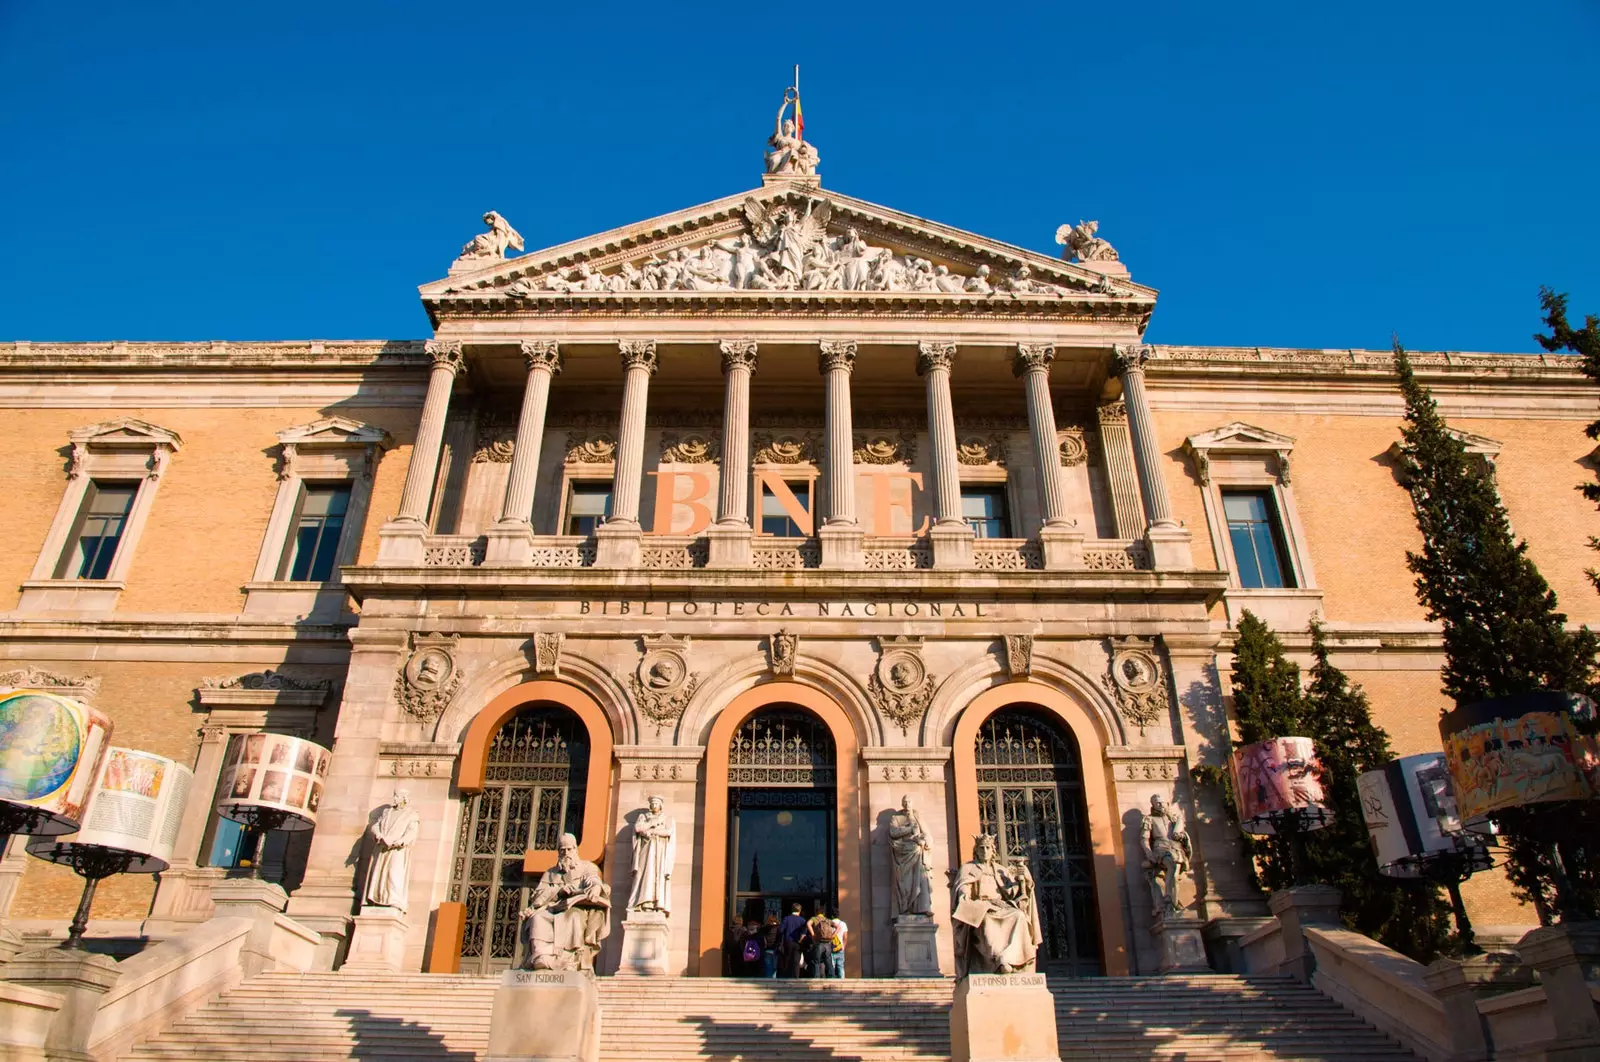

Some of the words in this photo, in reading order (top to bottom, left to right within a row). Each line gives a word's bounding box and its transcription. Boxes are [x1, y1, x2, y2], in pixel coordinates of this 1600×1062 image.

[579, 601, 795, 617] BIBLIOTECA
[817, 602, 988, 618] NACIONAL
[515, 974, 531, 984] SAN
[535, 974, 565, 984] ISIDORO
[972, 977, 1006, 987] ALFONSO
[1009, 977, 1020, 986] EL
[1021, 977, 1044, 986] SABIO
